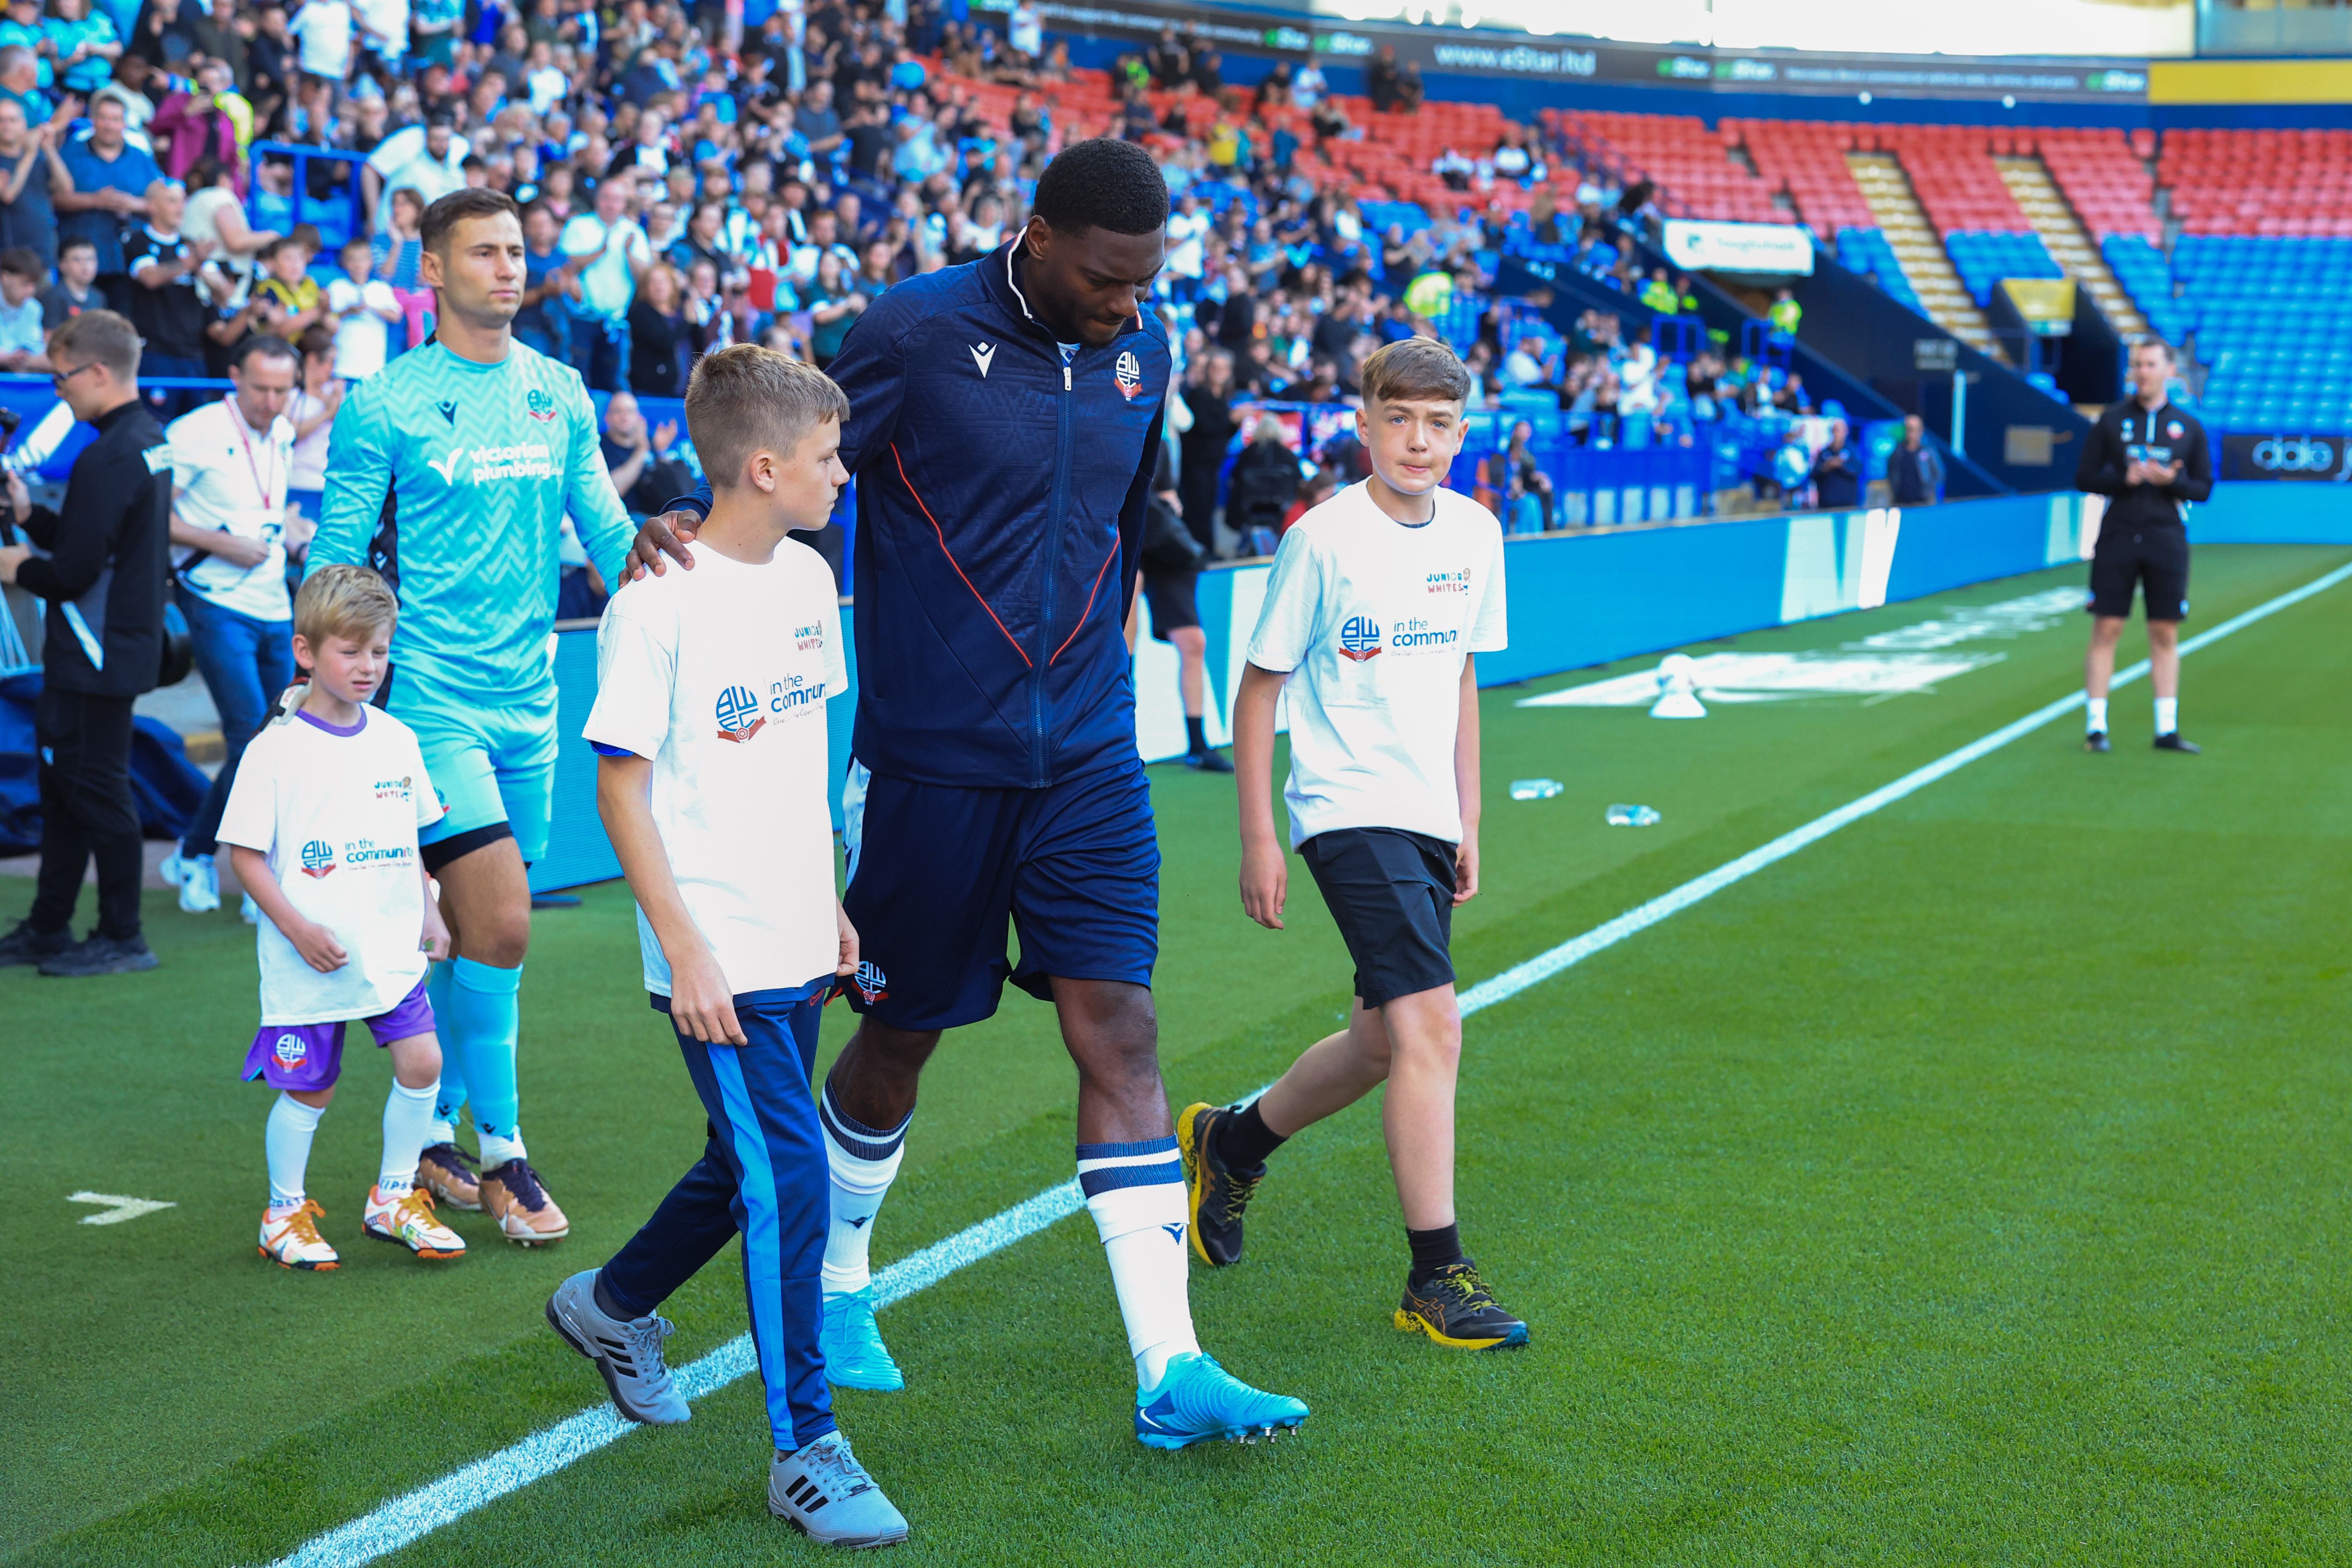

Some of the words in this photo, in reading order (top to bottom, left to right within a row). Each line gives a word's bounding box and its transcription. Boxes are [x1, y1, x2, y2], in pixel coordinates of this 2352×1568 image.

[469, 441, 549, 463] victorian
[1427, 573, 1462, 582] JUNIOR
[1428, 583, 1462, 593] WHITES
[1394, 620, 1404, 632] in
[1409, 617, 1428, 630] the
[770, 681, 782, 695] in
[784, 673, 803, 690] the
